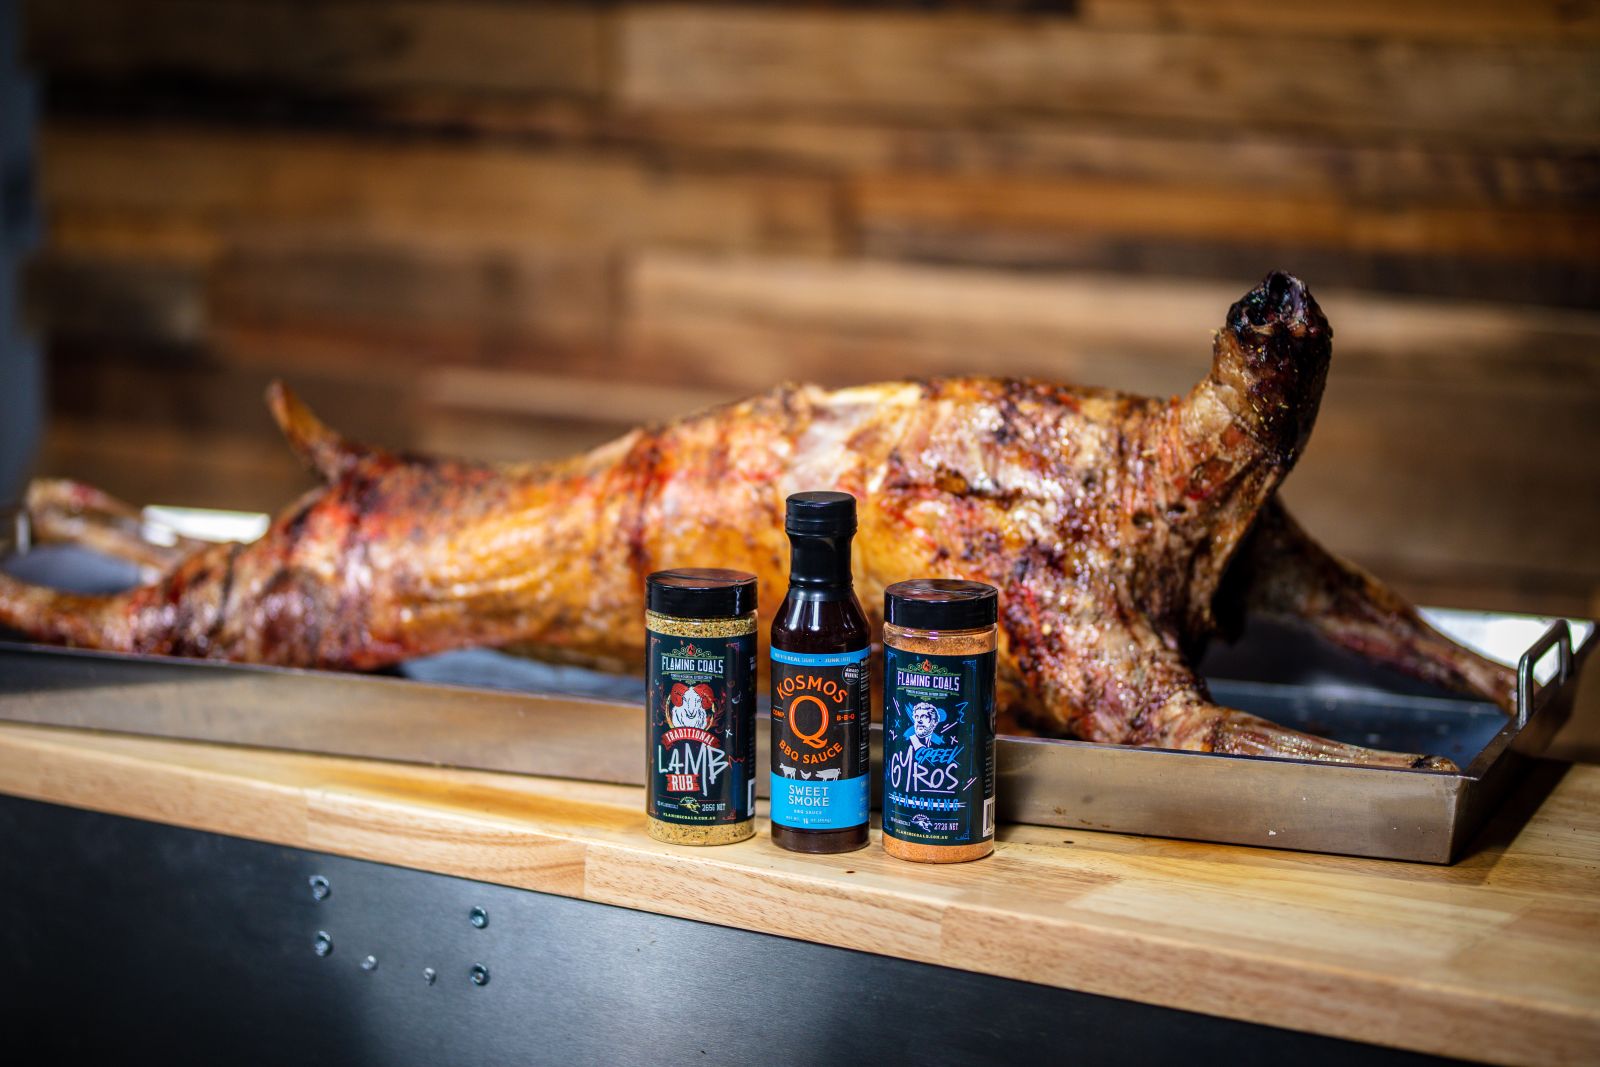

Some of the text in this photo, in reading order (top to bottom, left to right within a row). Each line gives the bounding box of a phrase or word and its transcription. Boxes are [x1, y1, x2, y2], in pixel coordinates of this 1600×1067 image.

[662, 656, 724, 674] FLAMING COALS
[777, 675, 848, 703] KOSMOS
[897, 671, 960, 692] FLAMING COALS
[788, 695, 830, 749] Q
[665, 728, 714, 745] TRADITIONAL
[779, 739, 799, 762] BBQ
[803, 742, 843, 764] SAUCE
[914, 744, 964, 767] GREEK
[658, 742, 729, 796] LAMB
[891, 745, 959, 793] GYROS
[671, 775, 694, 791] RUB
[788, 784, 830, 797] SWEET
[788, 795, 830, 807] SMOKE
[890, 792, 960, 812] SEASONING
[948, 822, 959, 831] NET
